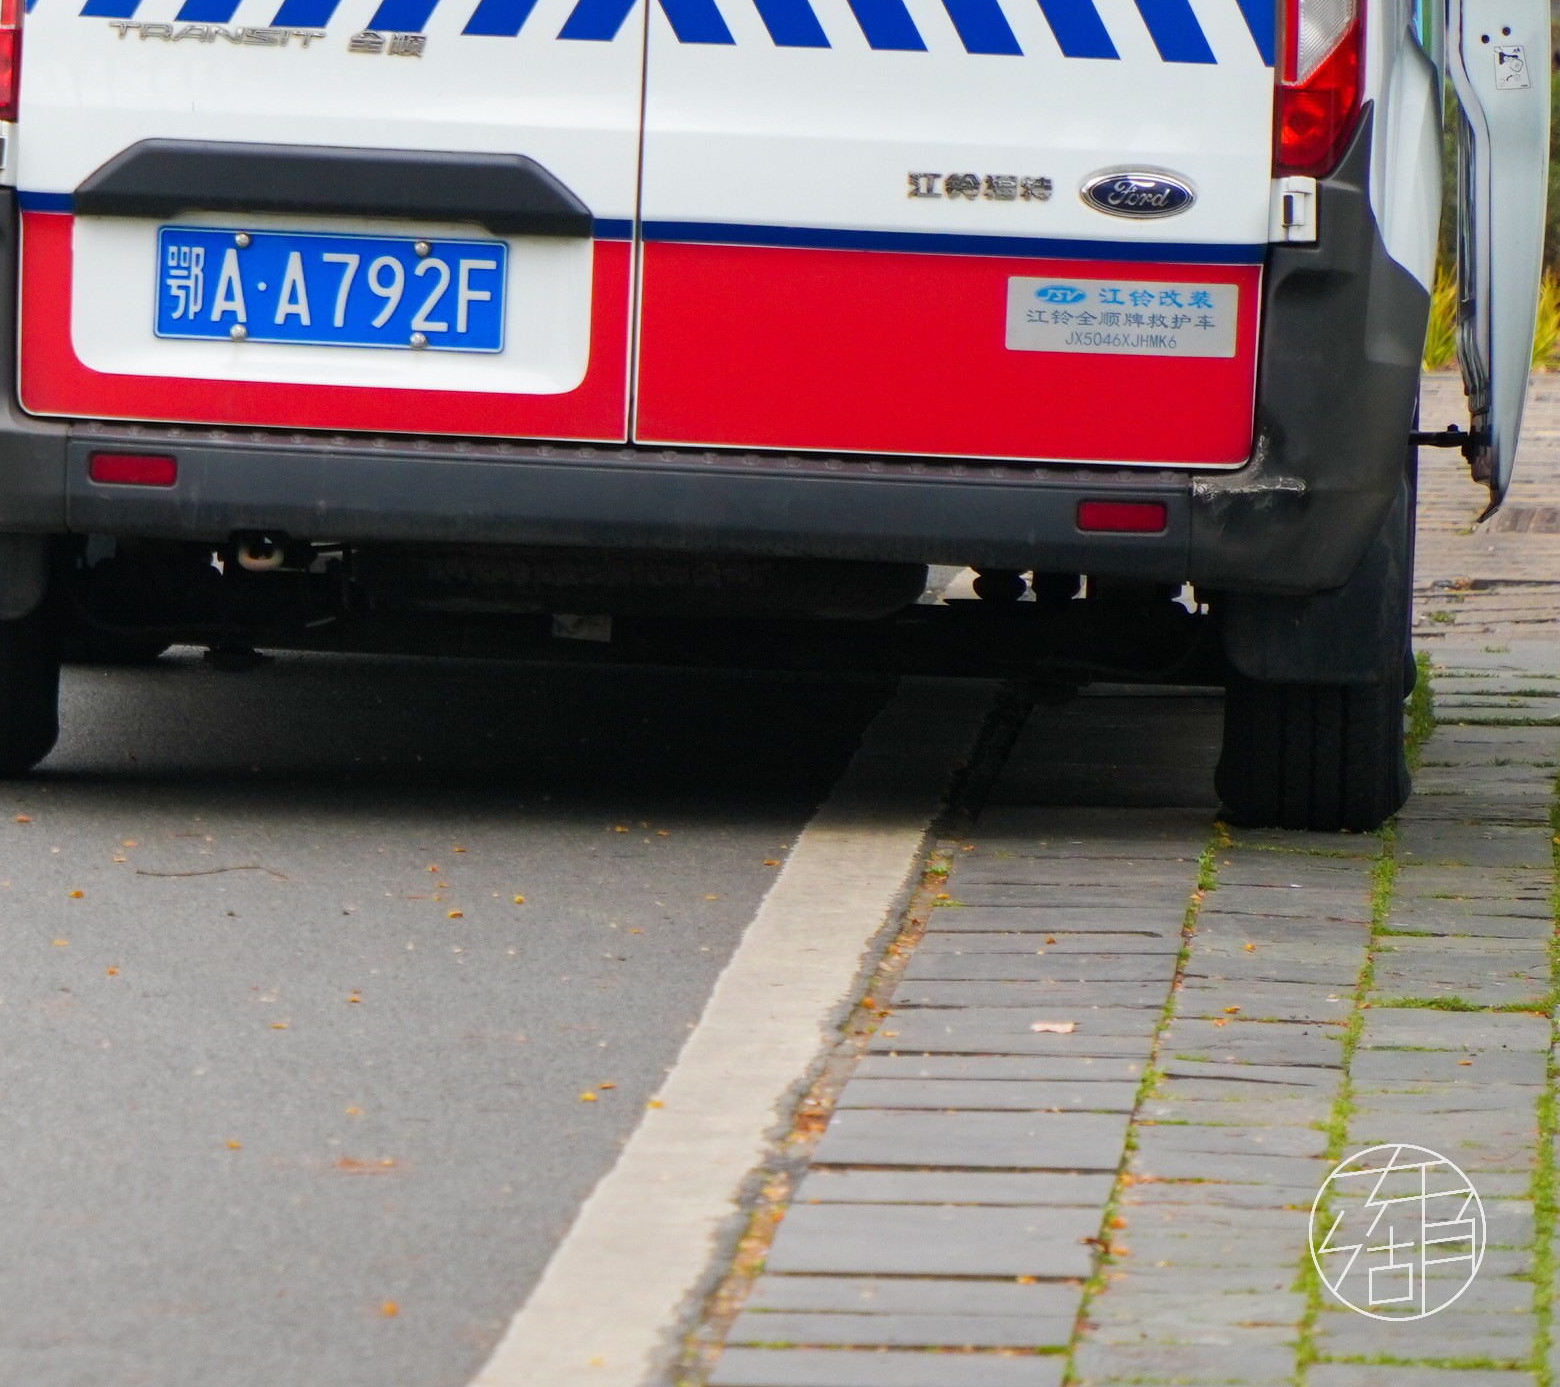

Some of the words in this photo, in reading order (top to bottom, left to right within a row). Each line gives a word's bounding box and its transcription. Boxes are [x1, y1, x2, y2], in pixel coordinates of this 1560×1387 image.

[108, 20, 326, 49] TRANSIT
[1106, 179, 1172, 209] Ford
[1097, 288, 1215, 309] 江铃改装
[1025, 308, 1217, 330] 江铃全顺牌救护车
[1064, 331, 1178, 349] JX5046XJHMK6
